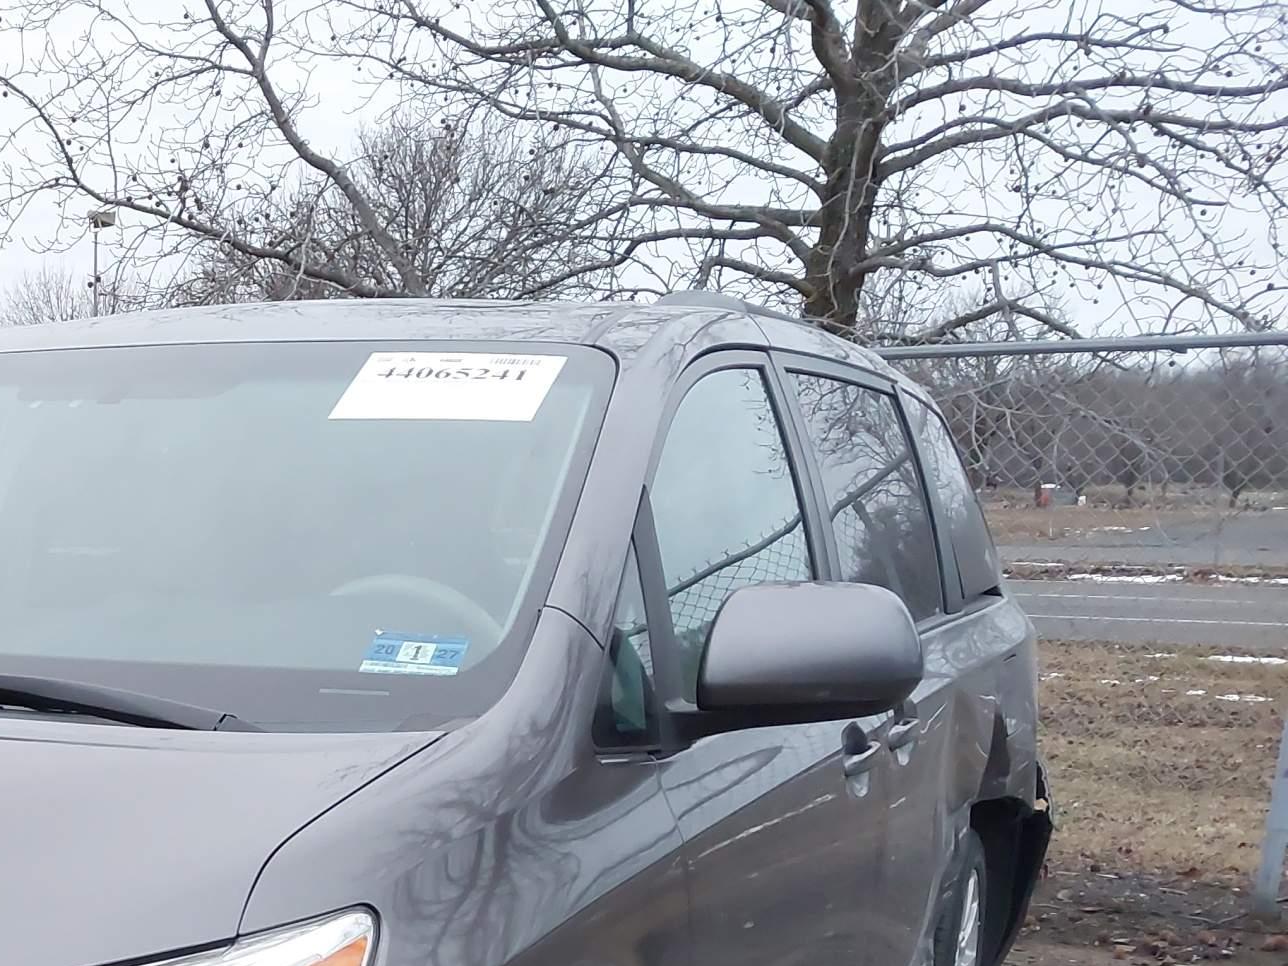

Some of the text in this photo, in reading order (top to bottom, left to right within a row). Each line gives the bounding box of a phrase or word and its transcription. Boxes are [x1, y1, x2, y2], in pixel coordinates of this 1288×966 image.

[376, 366, 528, 381] 44065241
[374, 644, 458, 661] 20 1 27
